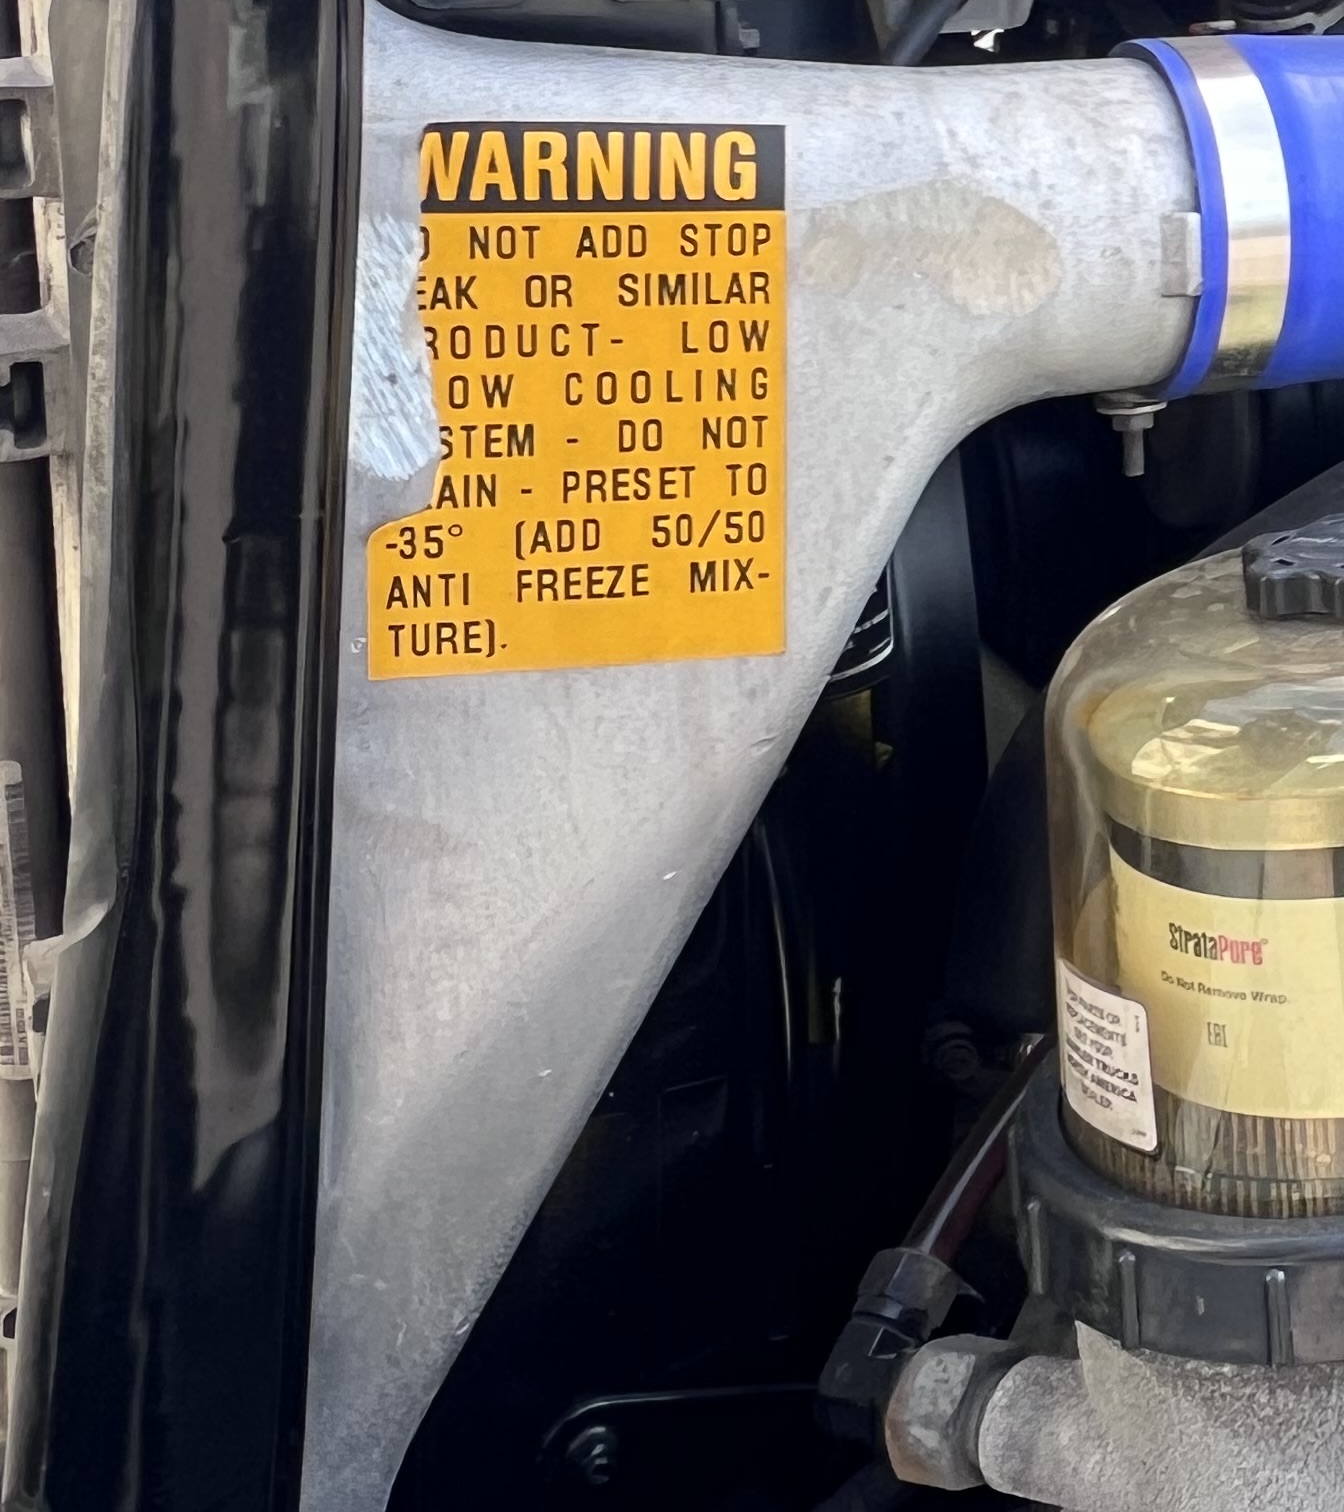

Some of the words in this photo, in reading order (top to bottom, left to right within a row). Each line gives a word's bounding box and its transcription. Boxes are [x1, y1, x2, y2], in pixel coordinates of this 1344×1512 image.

[470, 226, 541, 259] NOT
[576, 225, 647, 258] ADD
[679, 223, 771, 257] STOP
[416, 276, 478, 310] EAK
[525, 275, 573, 307] OR
[618, 272, 770, 306] SIMILAR
[424, 323, 624, 360] RODUCT-
[681, 321, 769, 354] LOW
[565, 368, 768, 404] COOLING
[618, 419, 663, 452] DO
[703, 415, 768, 450] NOT
[563, 466, 696, 502] PRESET
[726, 463, 767, 496] TO
[651, 510, 765, 549] 50/50
[387, 573, 470, 610] ANTI
[517, 564, 650, 603] FREEZE
[690, 558, 769, 594] MIX-
[1168, 923, 1263, 965] StrataPure
[1198, 983, 1246, 1000] Remove
